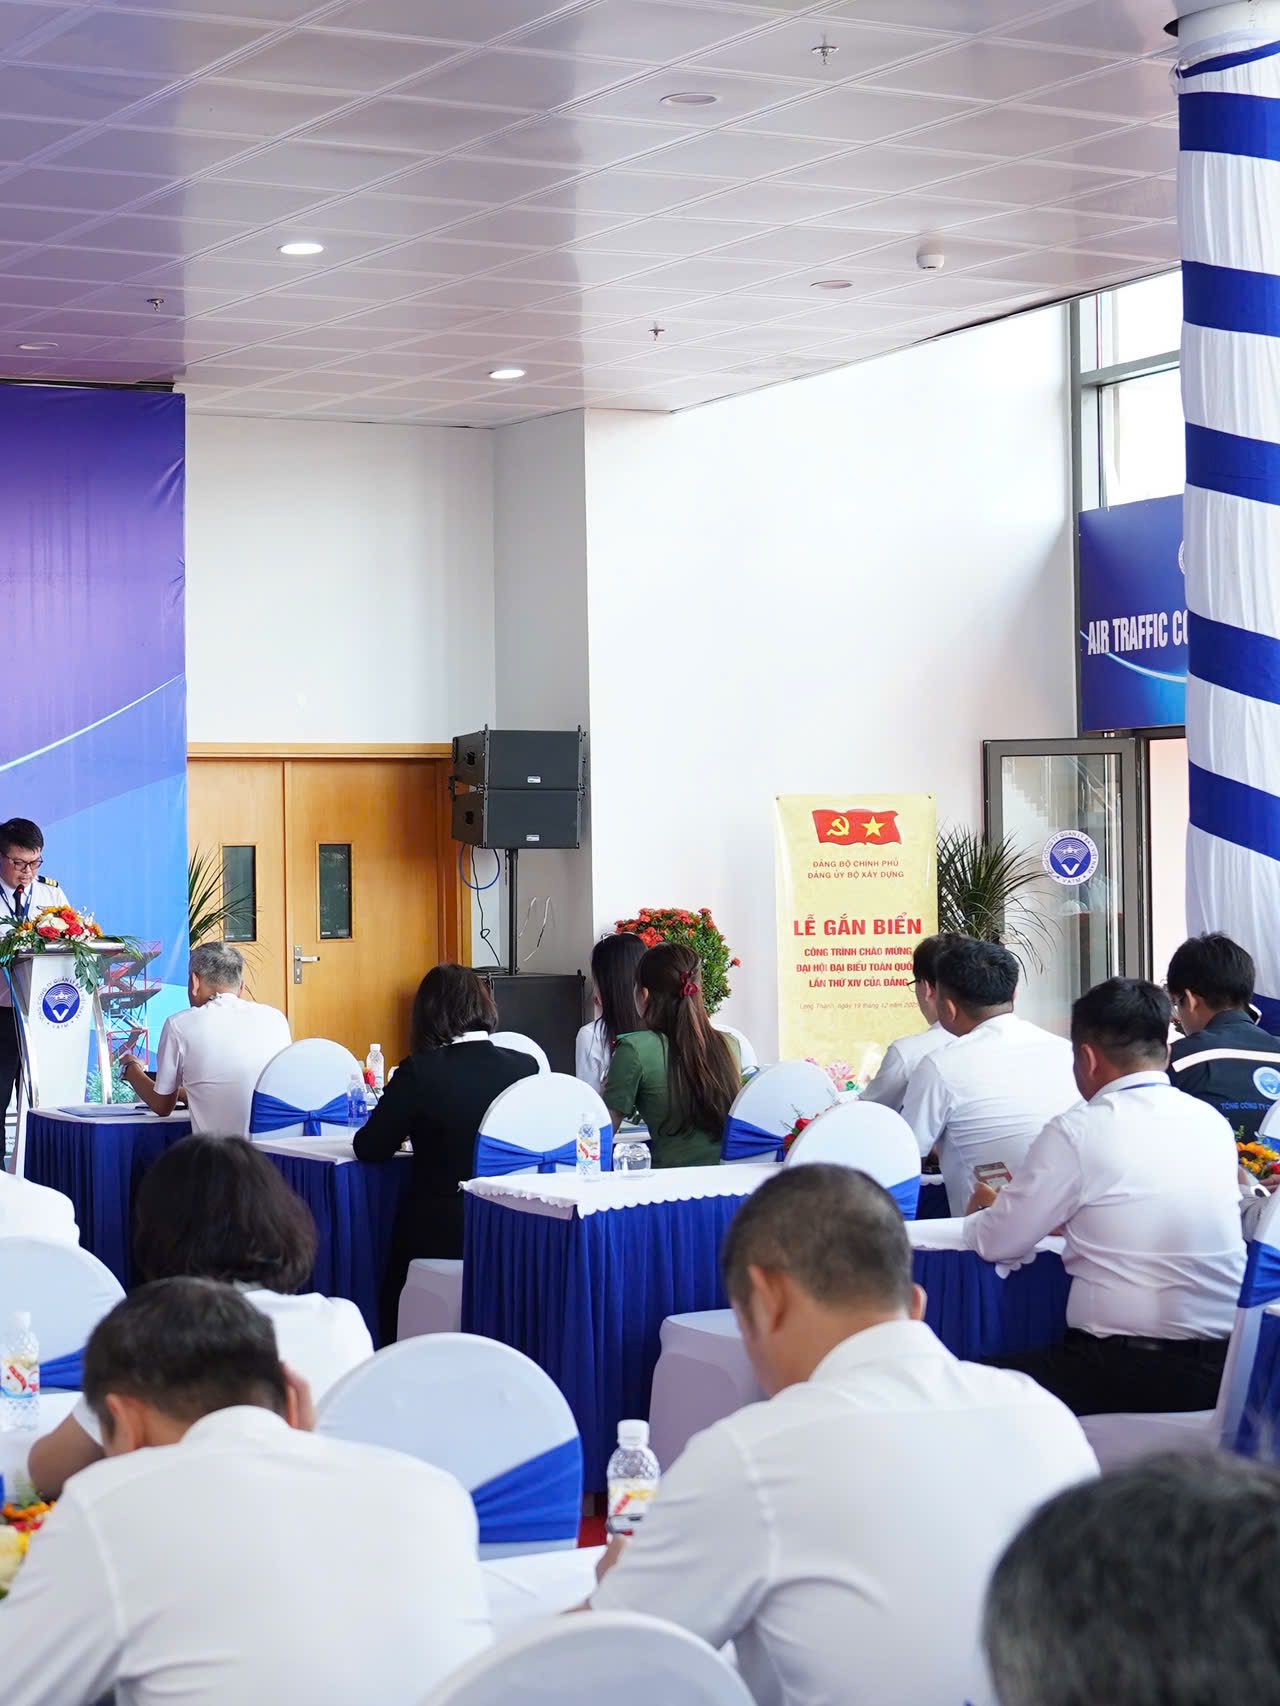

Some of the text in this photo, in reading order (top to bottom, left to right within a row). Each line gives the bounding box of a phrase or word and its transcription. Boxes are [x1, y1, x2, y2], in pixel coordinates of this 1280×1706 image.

[1088, 619, 1110, 655] AIR
[1113, 612, 1168, 653] TRAFFIC
[840, 859, 851, 869] BỘ
[853, 858, 879, 867] CHÍNH
[848, 870, 859, 879] BỘ
[881, 870, 904, 879] DỰNG
[794, 912, 922, 935] LỄ GẮN BIỂN
[804, 946, 828, 957] CÔNG
[831, 946, 857, 956] TRÌNH
[859, 946, 883, 956] CHÀO
[894, 960, 914, 971] QUỐ
[847, 979, 861, 987] XIV
